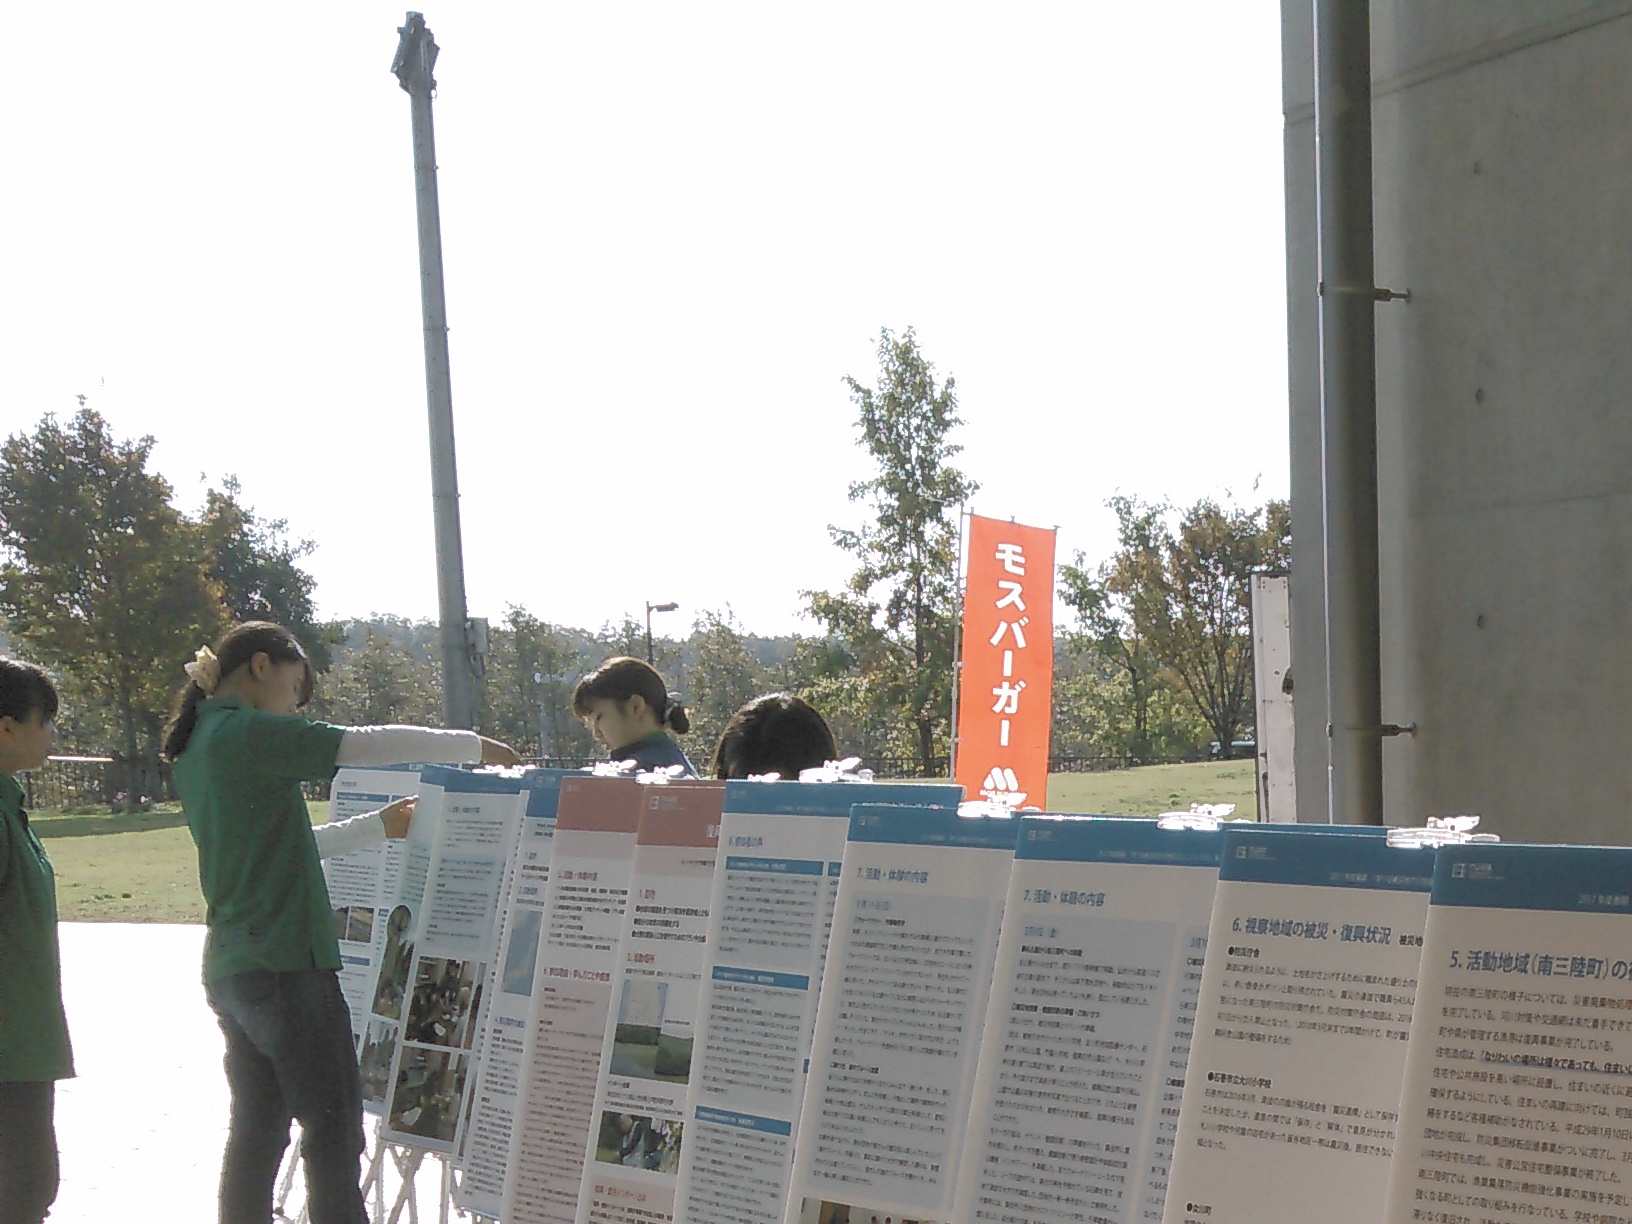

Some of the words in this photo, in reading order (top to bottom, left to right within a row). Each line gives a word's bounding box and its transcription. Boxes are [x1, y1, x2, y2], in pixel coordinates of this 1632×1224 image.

[990, 543, 1030, 747] モスバーガー
[1449, 950, 1462, 969] 5.
